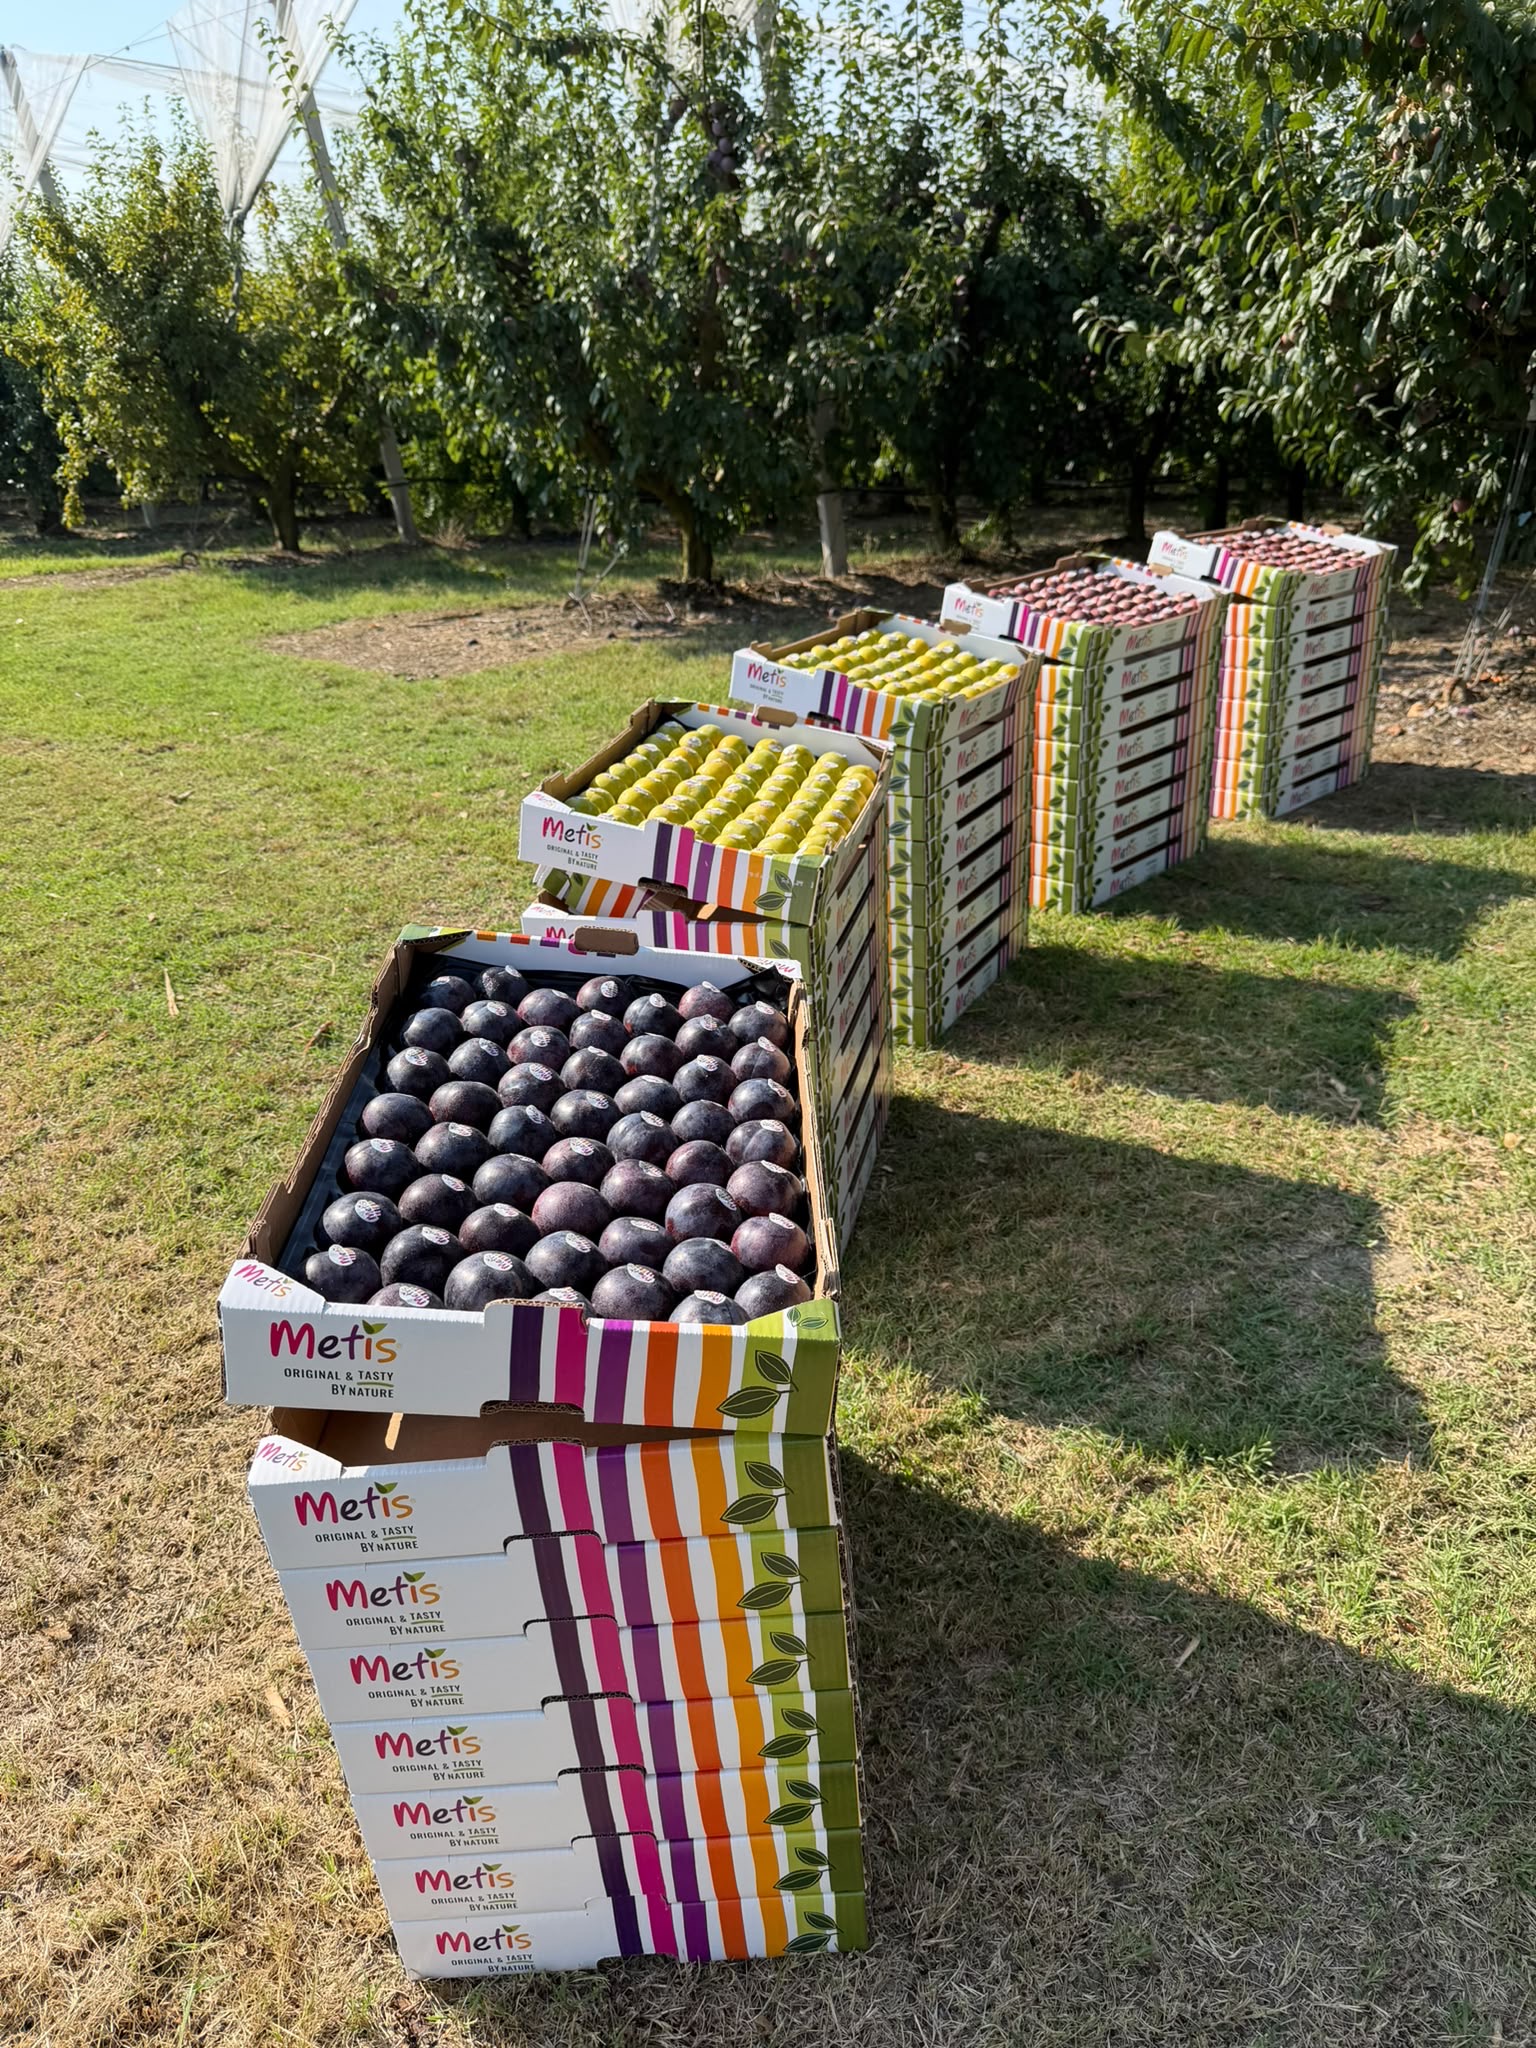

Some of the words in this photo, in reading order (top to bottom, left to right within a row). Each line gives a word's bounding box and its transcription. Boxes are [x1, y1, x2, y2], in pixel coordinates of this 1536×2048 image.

[747, 663, 786, 687] Metis
[542, 816, 602, 849] Metis
[235, 1264, 292, 1298] Metis
[269, 1320, 397, 1364] Metis
[284, 1368, 341, 1381] ORIGINAL
[345, 1372, 353, 1381] &
[357, 1370, 394, 1382] TASTY
[332, 1384, 347, 1396] BY
[349, 1387, 394, 1398] NATURE
[257, 1442, 308, 1472] Metis
[294, 1482, 413, 1526] Metis
[315, 1530, 367, 1543] ORIGINAL
[370, 1530, 378, 1538] &
[381, 1525, 414, 1536] TASTY
[360, 1542, 374, 1553] BY
[376, 1541, 419, 1552] NATURE
[326, 1572, 441, 1611] Metis
[346, 1615, 396, 1627] ORIGINAL
[410, 1611, 441, 1621] TASTY
[390, 1625, 403, 1636] BY
[405, 1625, 446, 1634] NATURE
[350, 1647, 460, 1685] Metis
[368, 1689, 417, 1699] ORIGINAL
[429, 1685, 461, 1694] TASTY
[410, 1698, 423, 1707] BY
[425, 1698, 464, 1707] NATURE
[375, 1726, 481, 1759] Metis
[392, 1763, 439, 1773] ORIGINAL
[452, 1759, 482, 1768] TASTY
[433, 1772, 446, 1781] BY
[448, 1771, 485, 1780] NATURE
[393, 1796, 496, 1827] Metis
[410, 1831, 455, 1840] ORIGINAL
[468, 1827, 496, 1835] TASTY
[449, 1839, 462, 1847] BY
[464, 1838, 500, 1846] NATURE
[415, 1863, 514, 1894] Metis
[431, 1896, 474, 1905] ORIGINAL
[487, 1892, 515, 1900] TASTY
[469, 1903, 481, 1912] BY
[436, 1924, 532, 1955] Metis
[451, 1958, 494, 1966] ORIGINAL
[488, 1964, 499, 1973] BY
[501, 1964, 536, 1972] NATURE
